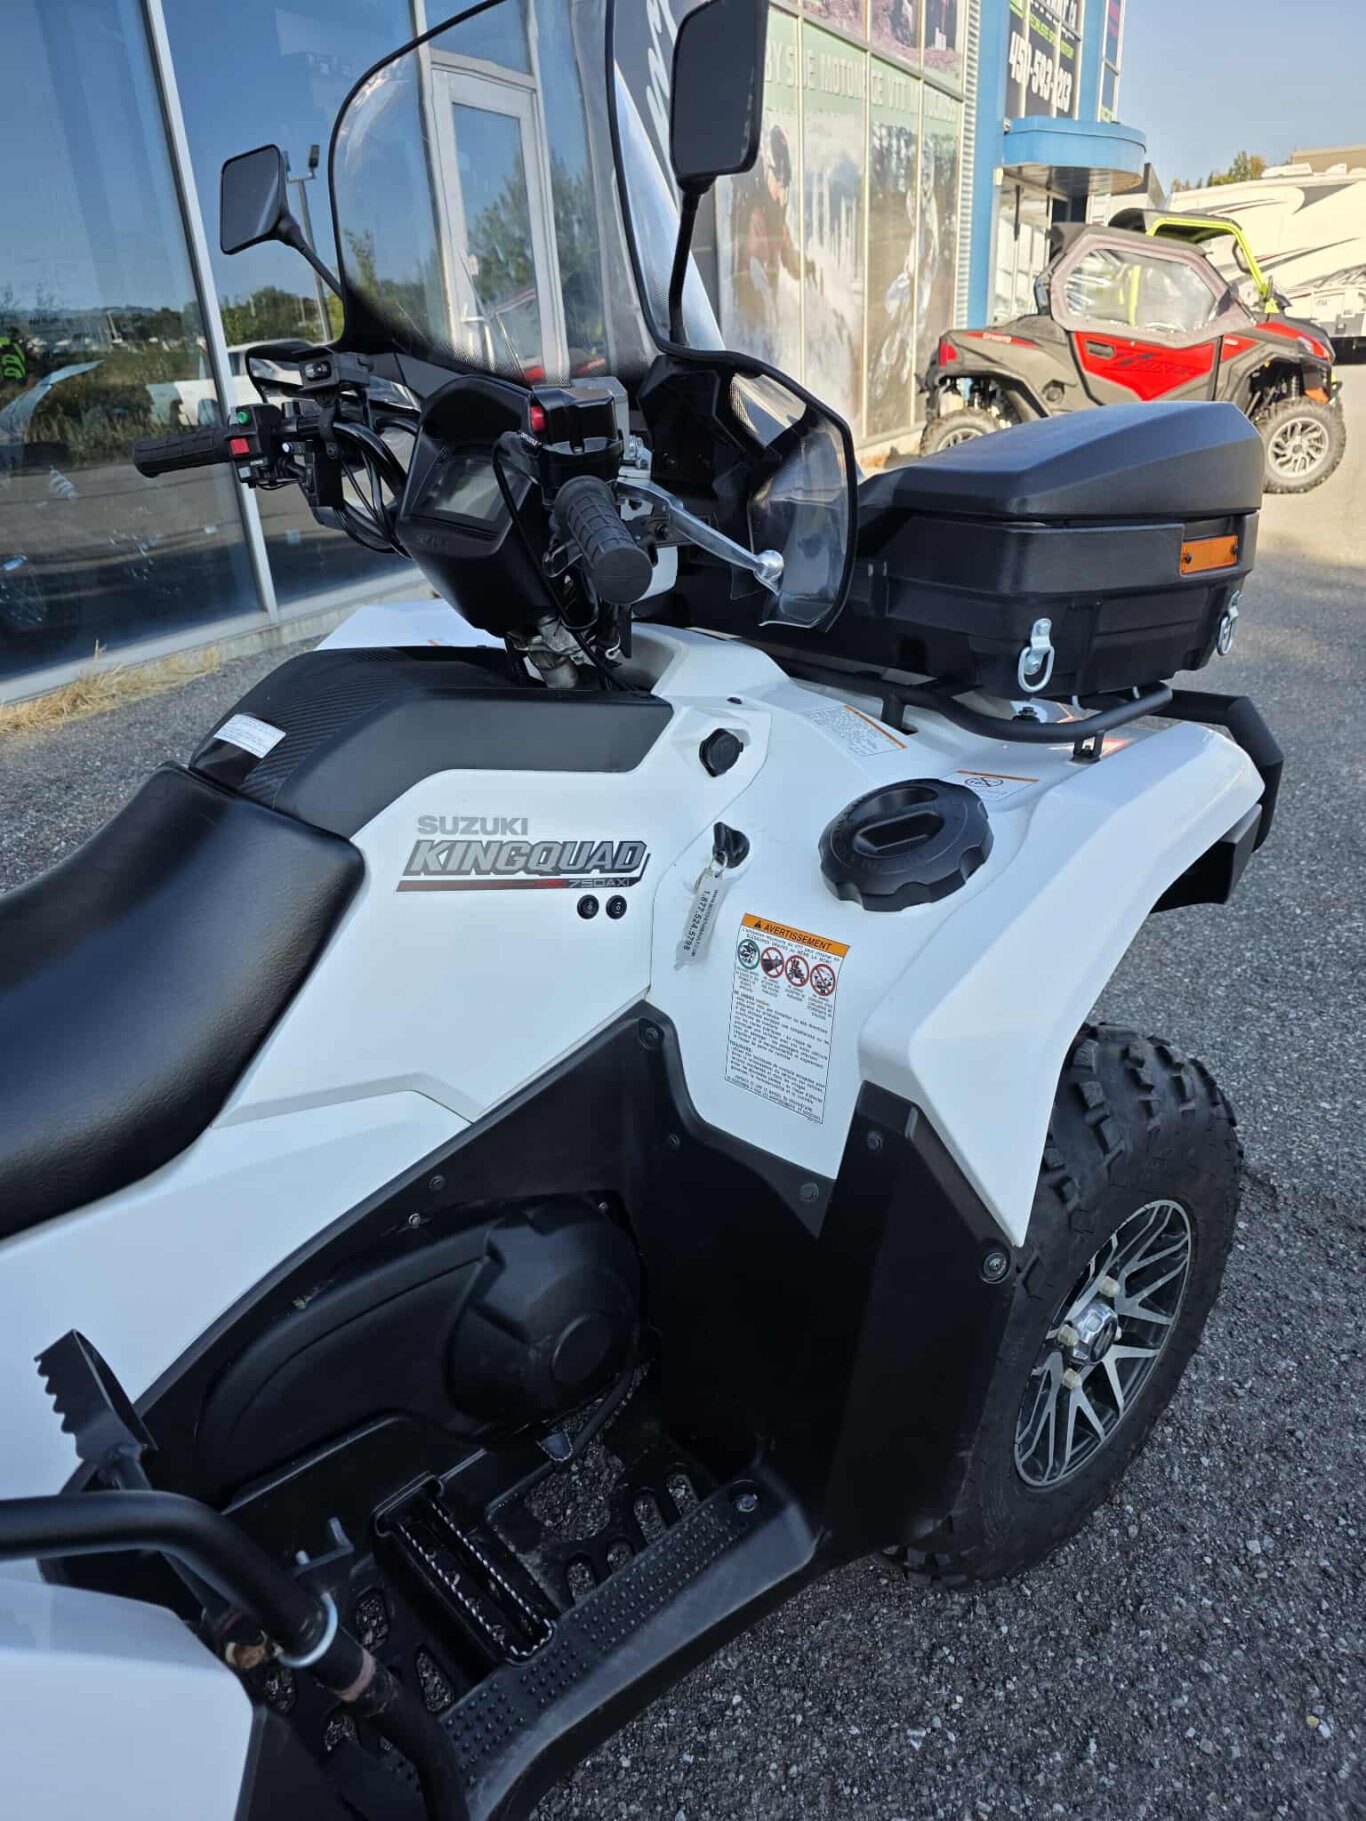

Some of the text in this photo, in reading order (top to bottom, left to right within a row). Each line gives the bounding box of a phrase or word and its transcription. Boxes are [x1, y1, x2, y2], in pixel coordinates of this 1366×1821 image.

[417, 815, 529, 836] SUZUKI
[402, 839, 648, 877] KINGQUAD
[764, 924, 833, 951] AVERTISSEMENT
